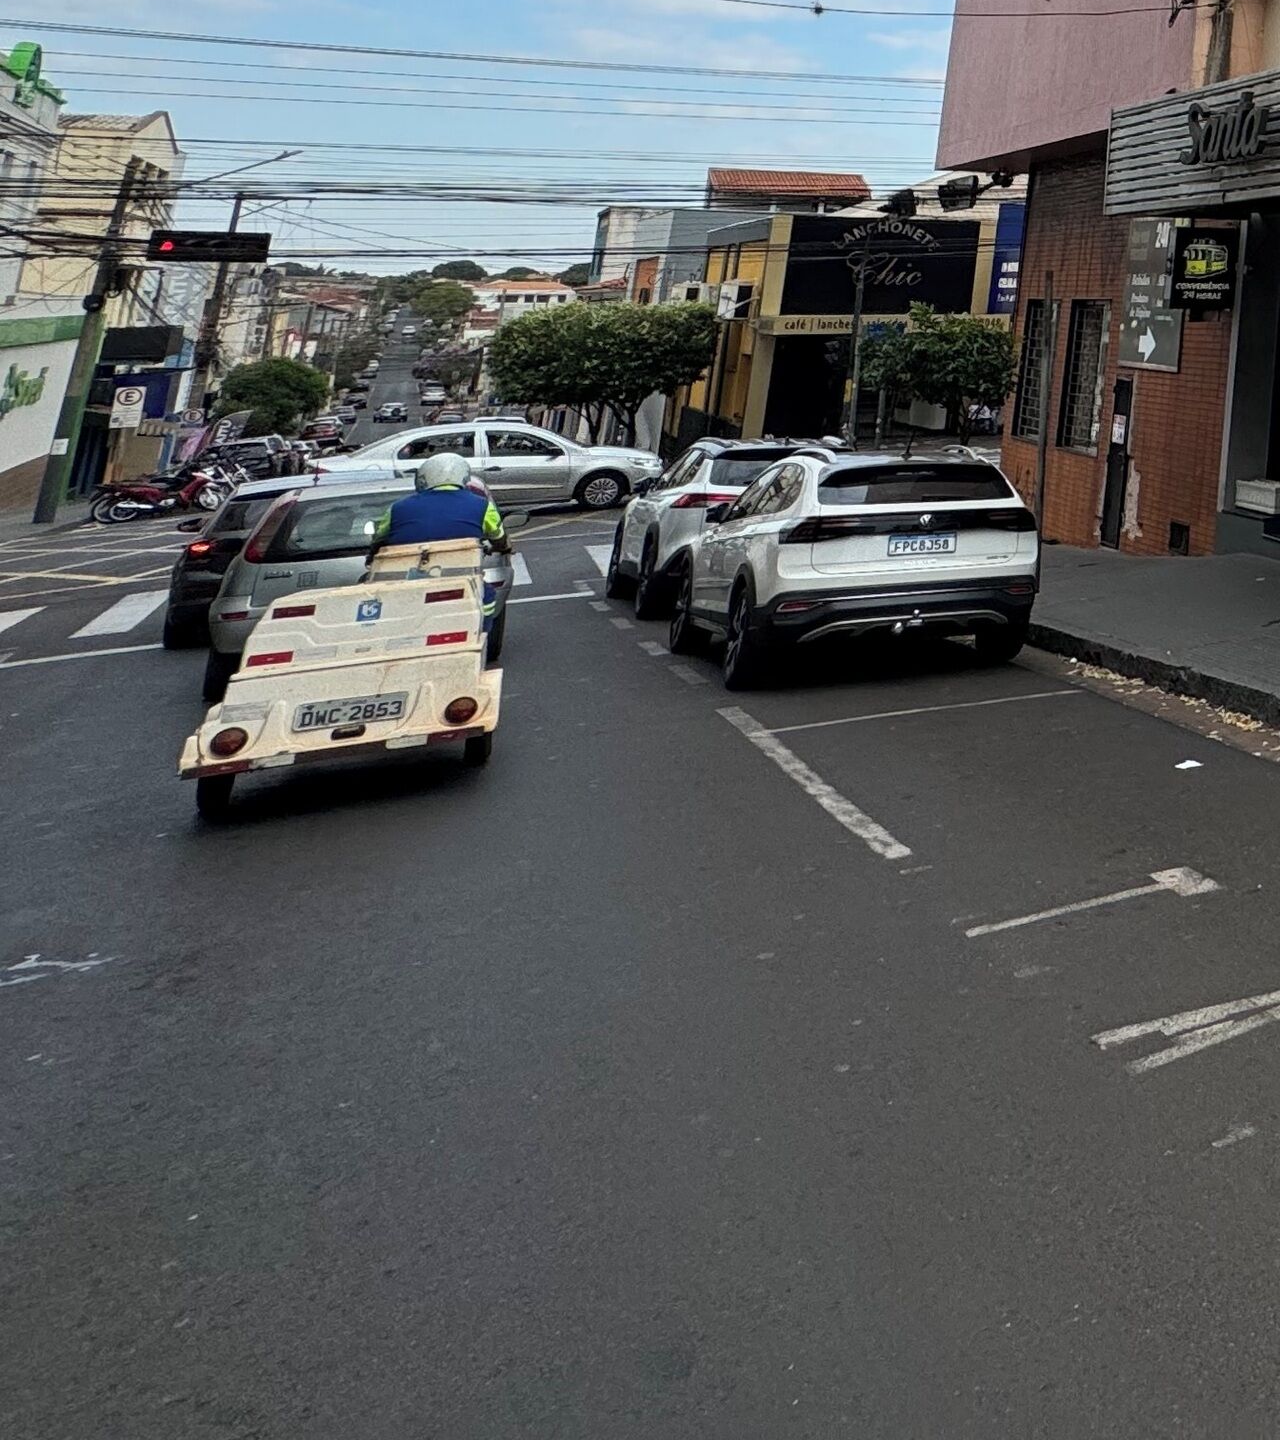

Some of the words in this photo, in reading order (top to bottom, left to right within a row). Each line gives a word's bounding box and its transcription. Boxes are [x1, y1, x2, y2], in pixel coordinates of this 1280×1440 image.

[1181, 90, 1268, 166] Santa
[832, 220, 942, 251] LANCHONETE
[846, 250, 923, 287] Chic
[784, 318, 806, 330] café
[124, 391, 136, 403] E
